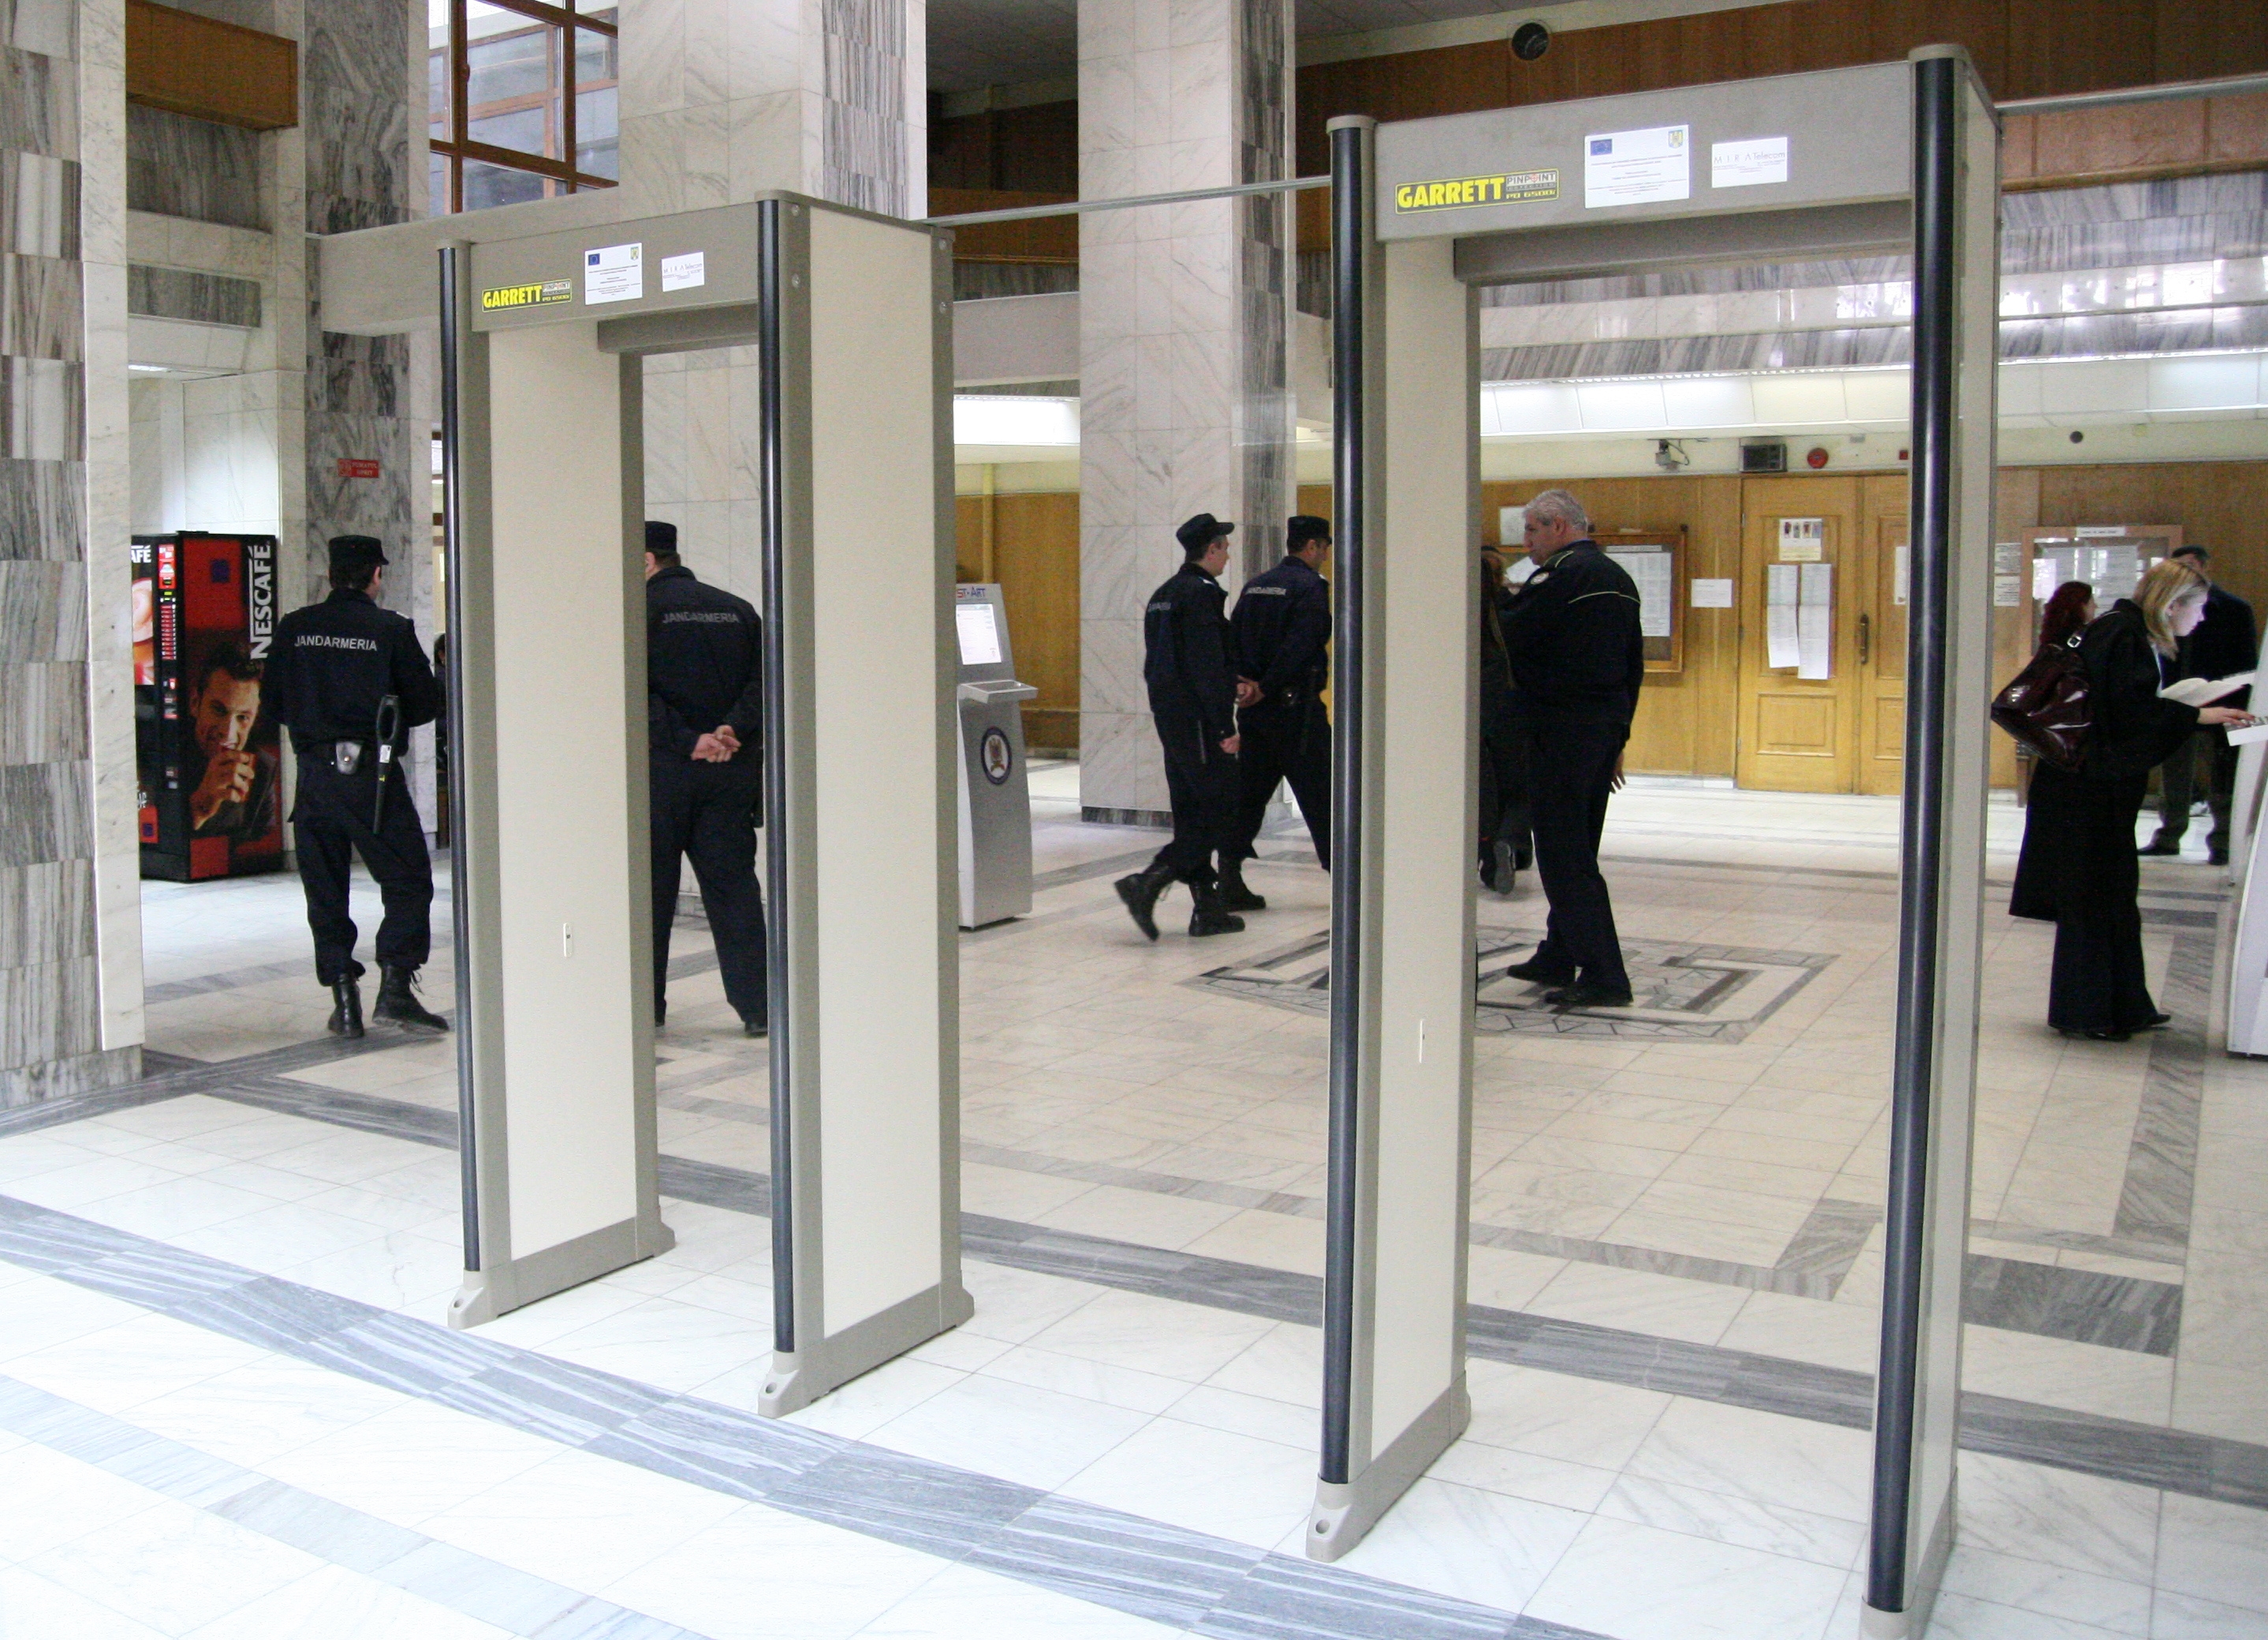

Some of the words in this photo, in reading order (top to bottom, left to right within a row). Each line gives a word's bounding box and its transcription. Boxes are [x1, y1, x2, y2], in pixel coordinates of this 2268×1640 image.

[1752, 151, 1785, 160] Telecom
[1506, 172, 1556, 184] PINPOINT
[1397, 177, 1505, 209] GARRETT
[483, 285, 543, 308] GARRETT
[248, 543, 273, 661] NESCAFÉ
[294, 635, 378, 652] JANDARMERIA
